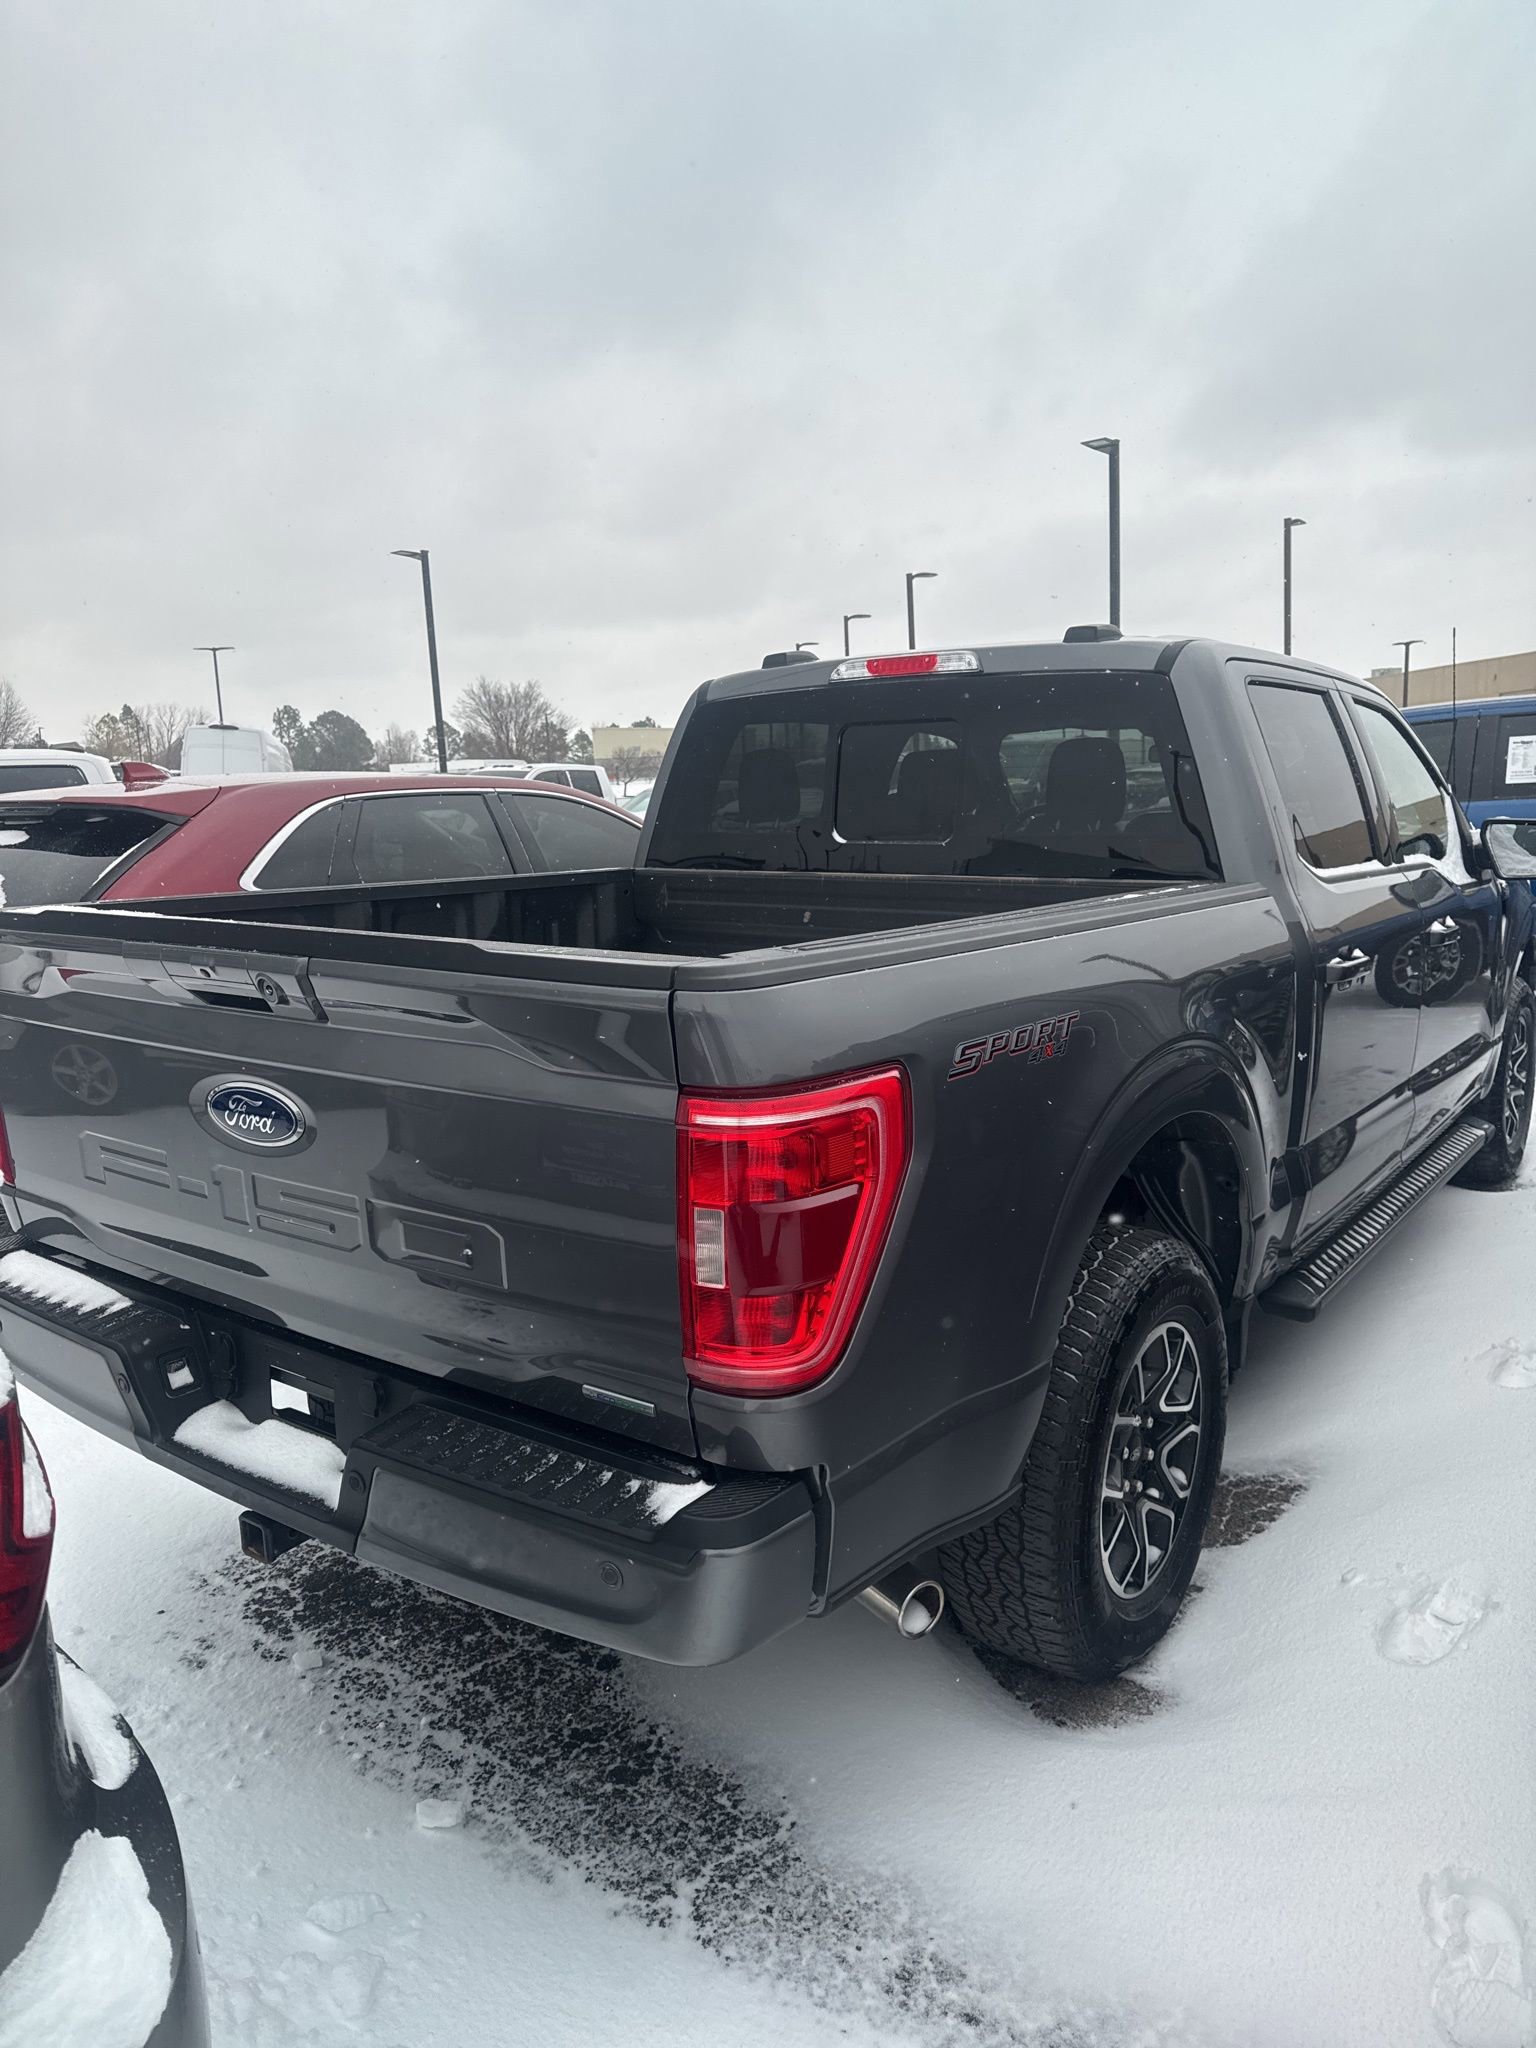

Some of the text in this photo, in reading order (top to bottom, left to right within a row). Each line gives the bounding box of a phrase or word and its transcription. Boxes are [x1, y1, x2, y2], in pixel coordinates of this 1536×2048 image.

[947, 1010, 1081, 1082] SPORT
[224, 1094, 276, 1134] Ford
[79, 1129, 509, 1290] F-150
